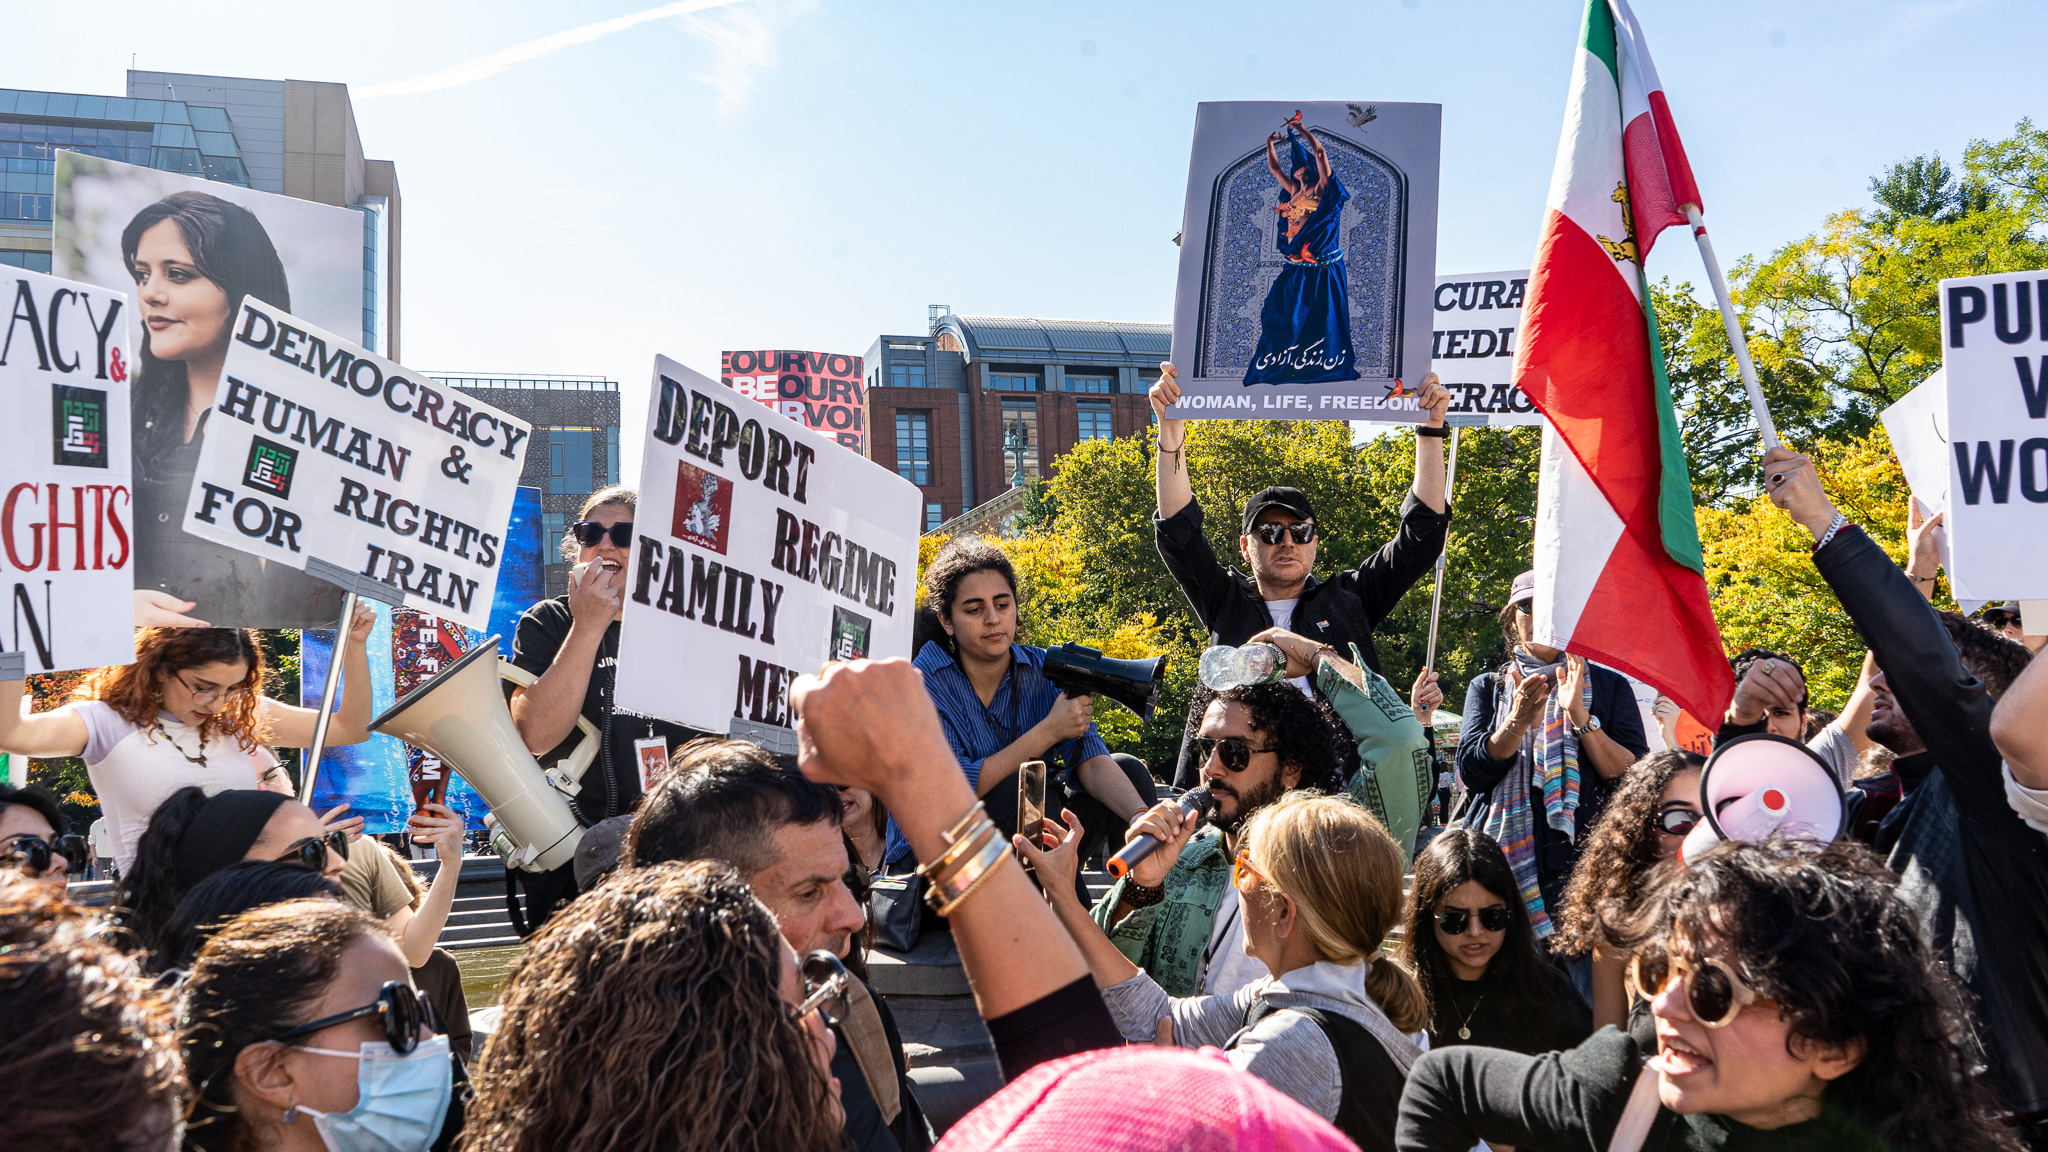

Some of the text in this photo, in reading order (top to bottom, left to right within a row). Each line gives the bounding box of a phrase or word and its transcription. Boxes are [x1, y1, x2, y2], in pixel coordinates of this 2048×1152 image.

[1947, 279, 2048, 348] PU
[236, 304, 529, 461] DEMOCRACY
[1175, 394, 1421, 412] WOMAN, LIFE, FREEDOM
[218, 375, 411, 483] HUMAN
[440, 444, 473, 485] &
[652, 374, 816, 505] DEPORT
[194, 481, 302, 554] FOR
[333, 477, 499, 568] RIGHTS
[771, 507, 897, 617] REGIME
[360, 541, 480, 614] IRAN
[631, 534, 784, 646] FAMILY
[0, 579, 55, 670] N
